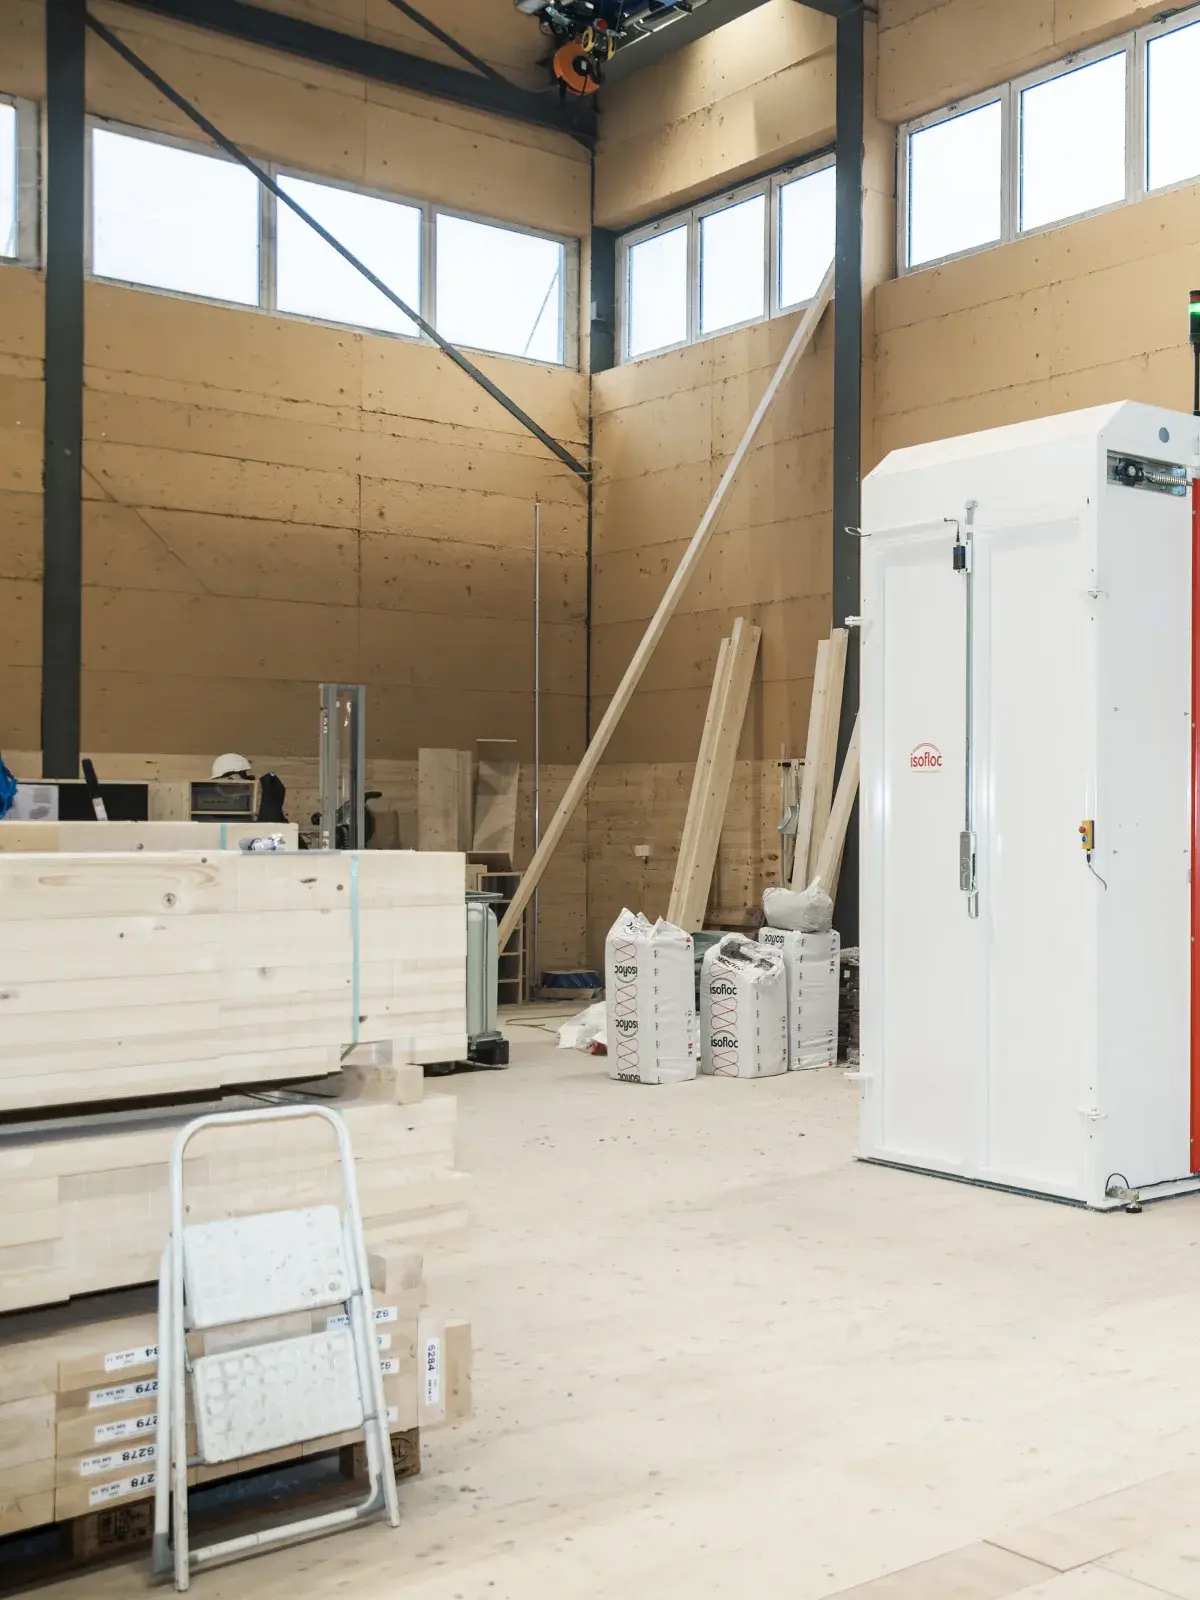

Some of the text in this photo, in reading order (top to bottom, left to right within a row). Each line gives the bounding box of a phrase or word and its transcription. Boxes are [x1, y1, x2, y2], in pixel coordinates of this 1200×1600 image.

[910, 752, 943, 767] isofloc
[614, 965, 638, 978] isofloc
[709, 982, 738, 996] isofloc
[615, 1019, 639, 1031] isofloc
[710, 1036, 739, 1049] isofloc
[135, 1381, 159, 1394] 279
[136, 1415, 158, 1429] 279
[122, 1446, 156, 1461] 6278
[131, 1473, 156, 1488] 278
